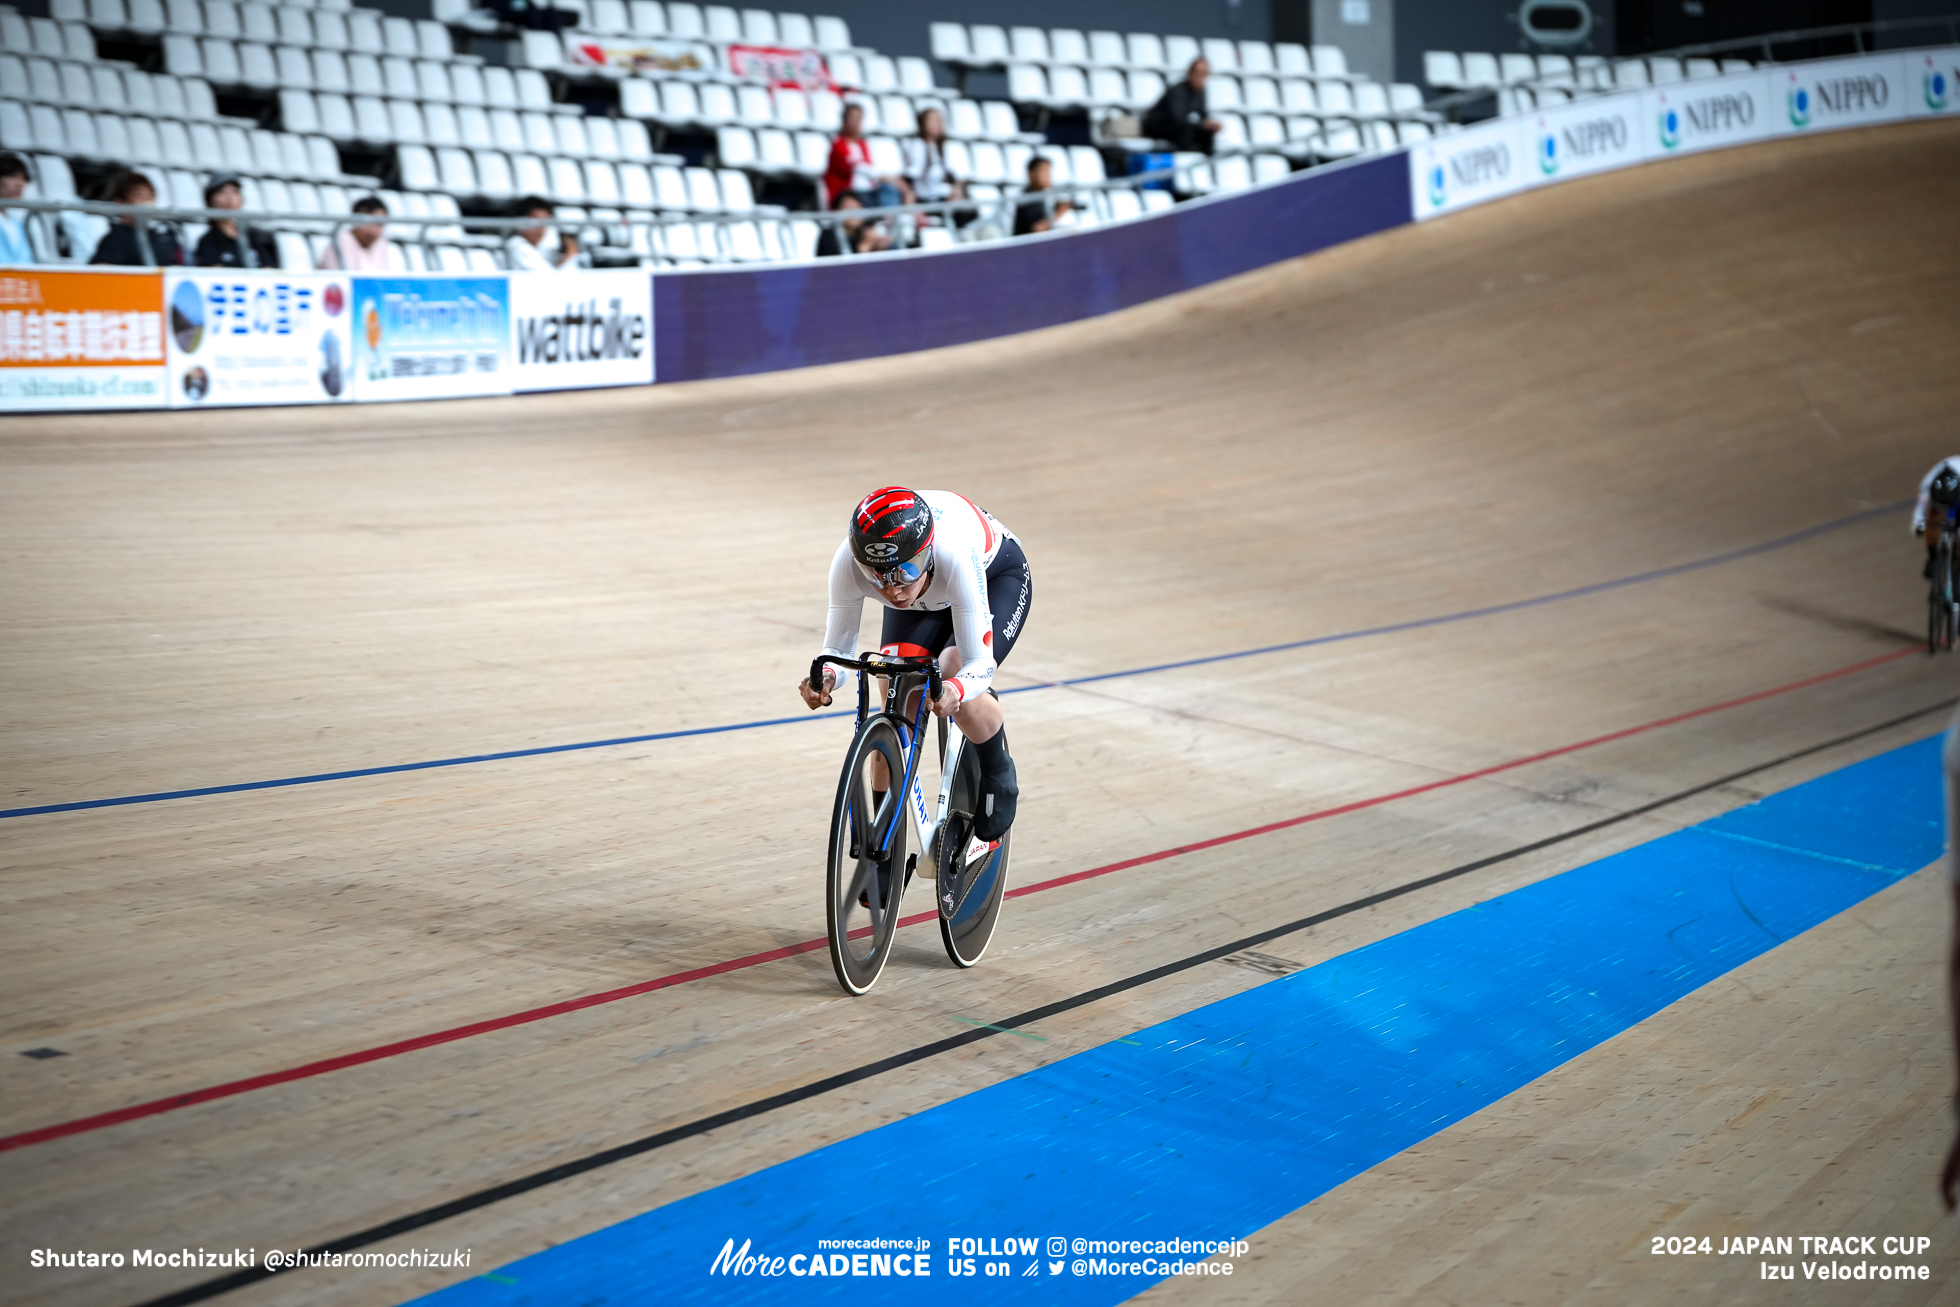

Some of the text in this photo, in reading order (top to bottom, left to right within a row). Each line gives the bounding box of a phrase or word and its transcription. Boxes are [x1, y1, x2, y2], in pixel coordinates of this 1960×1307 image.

[1685, 92, 1754, 131] NIPPO
[1815, 74, 1888, 113] NIPPO
[1563, 115, 1627, 157] NIPPO
[1450, 143, 1510, 188] NIPPO
[517, 297, 644, 364] wattbike
[913, 775, 929, 825] ORAY
[968, 843, 988, 857] JAPAN
